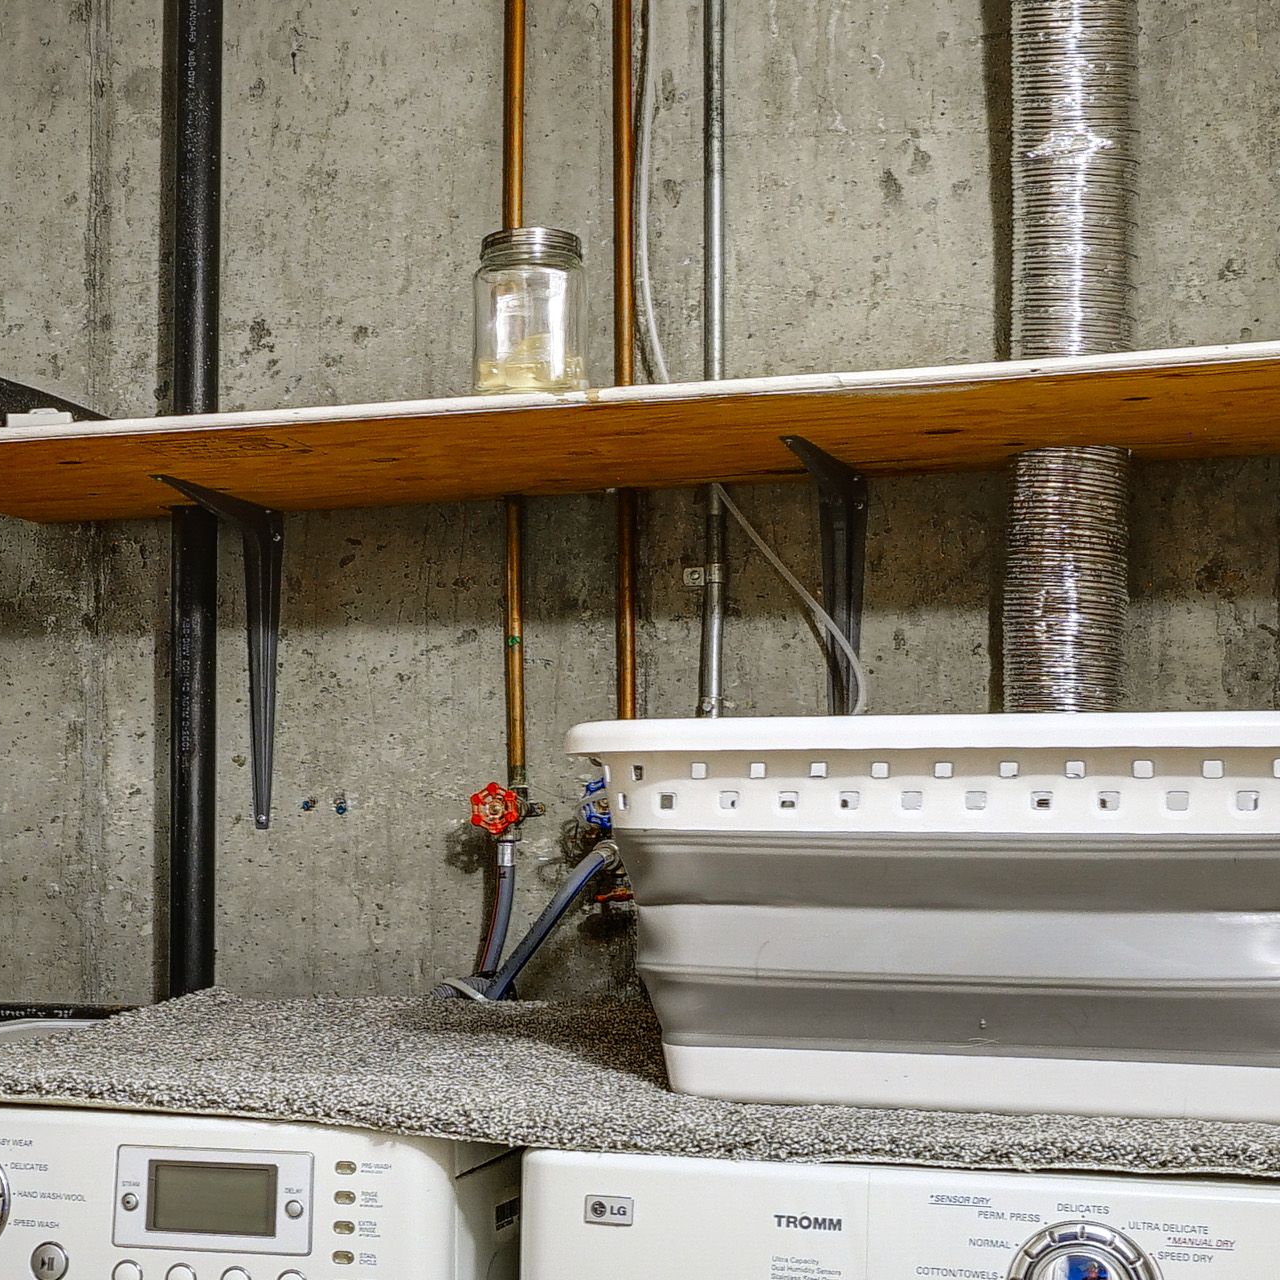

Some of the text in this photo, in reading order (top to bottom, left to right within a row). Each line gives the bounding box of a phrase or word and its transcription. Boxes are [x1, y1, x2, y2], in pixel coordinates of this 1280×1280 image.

[12, 1139, 33, 1147] WEAR
[10, 1162, 49, 1172] DELICATES
[17, 1191, 38, 1199] HAND
[971, 1196, 992, 1206] DRY
[609, 1204, 628, 1217] LG
[1056, 1202, 1111, 1215] DELICATES
[977, 1210, 1041, 1223] PERM. PRESS
[13, 1218, 60, 1229] SPEED WASH
[772, 1214, 843, 1232] TROMM
[1128, 1220, 1209, 1235] ULTRA DELICATE
[968, 1237, 1012, 1250] NORMAL
[1215, 1238, 1236, 1249] DRY
[771, 1255, 819, 1266] Ultra Capacity
[1157, 1250, 1214, 1263] SPEED DRY
[770, 1264, 786, 1272] Dual
[786, 1264, 815, 1275] Humidity
